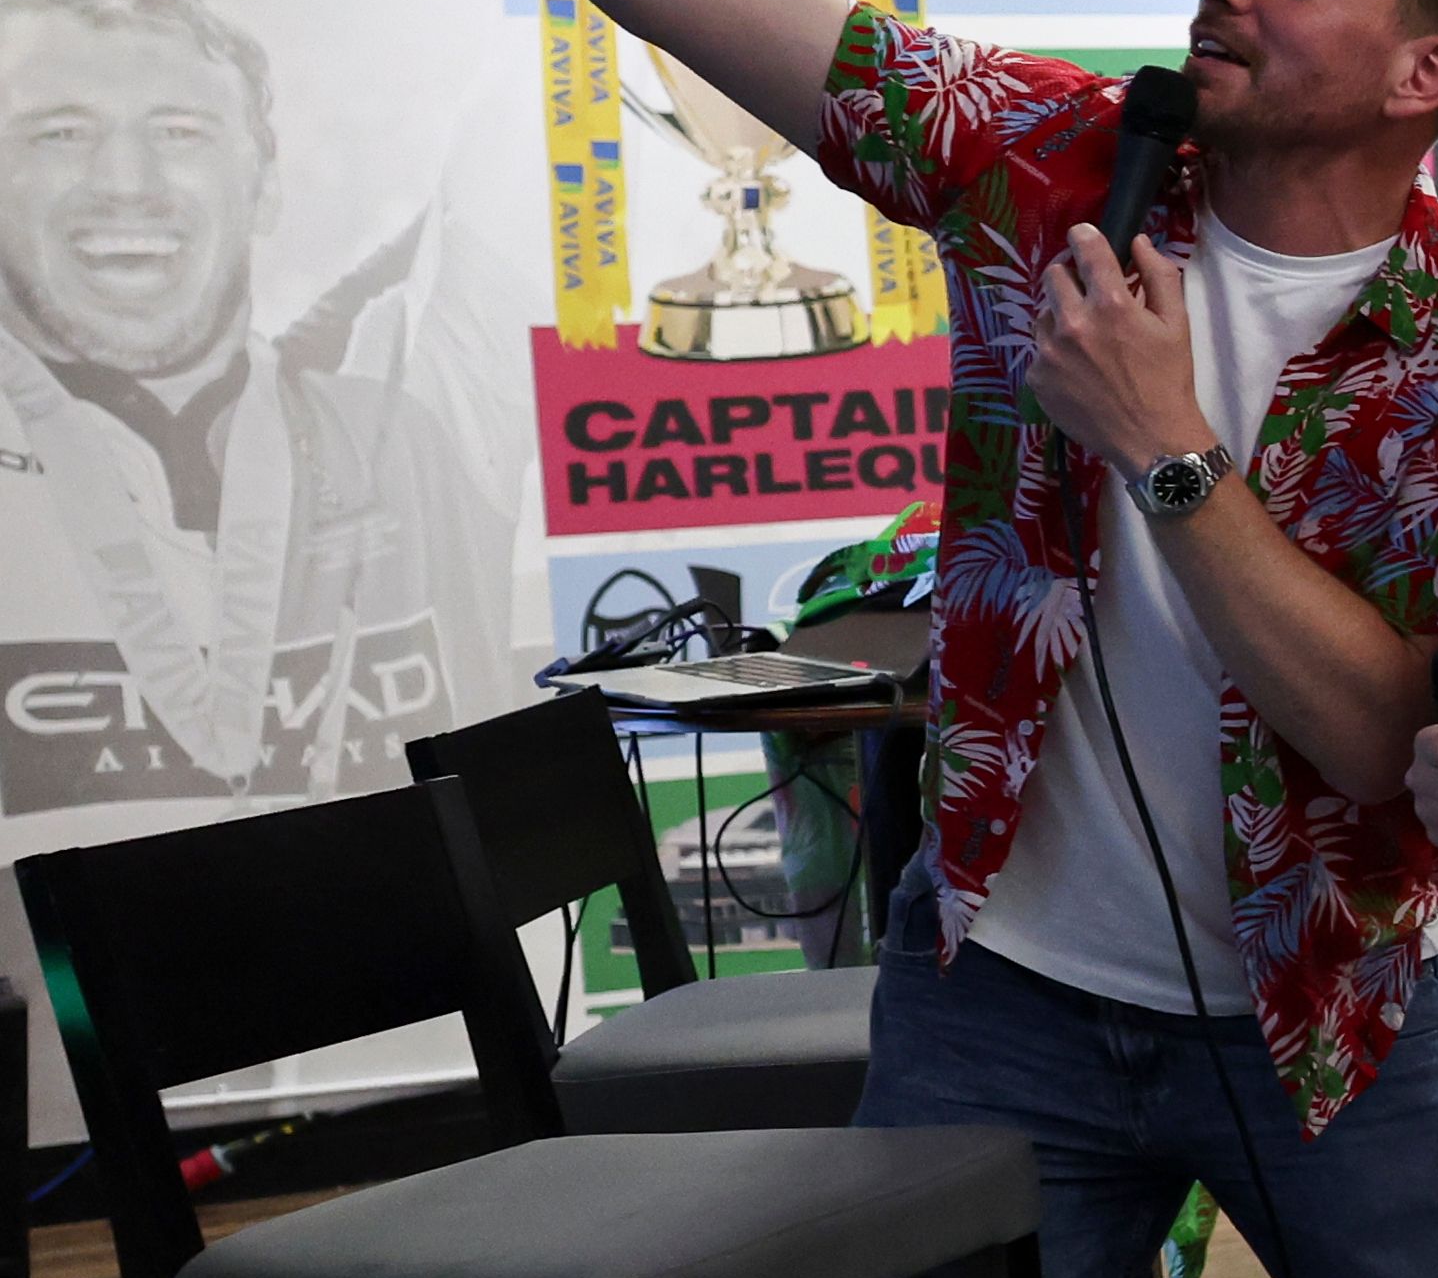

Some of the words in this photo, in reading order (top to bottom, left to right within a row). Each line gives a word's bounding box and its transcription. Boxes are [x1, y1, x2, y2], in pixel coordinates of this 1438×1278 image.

[550, 36, 575, 127] AVIVA
[585, 14, 611, 104] AVIVA
[559, 200, 584, 291] AVIVA
[592, 177, 618, 268] AVIVA
